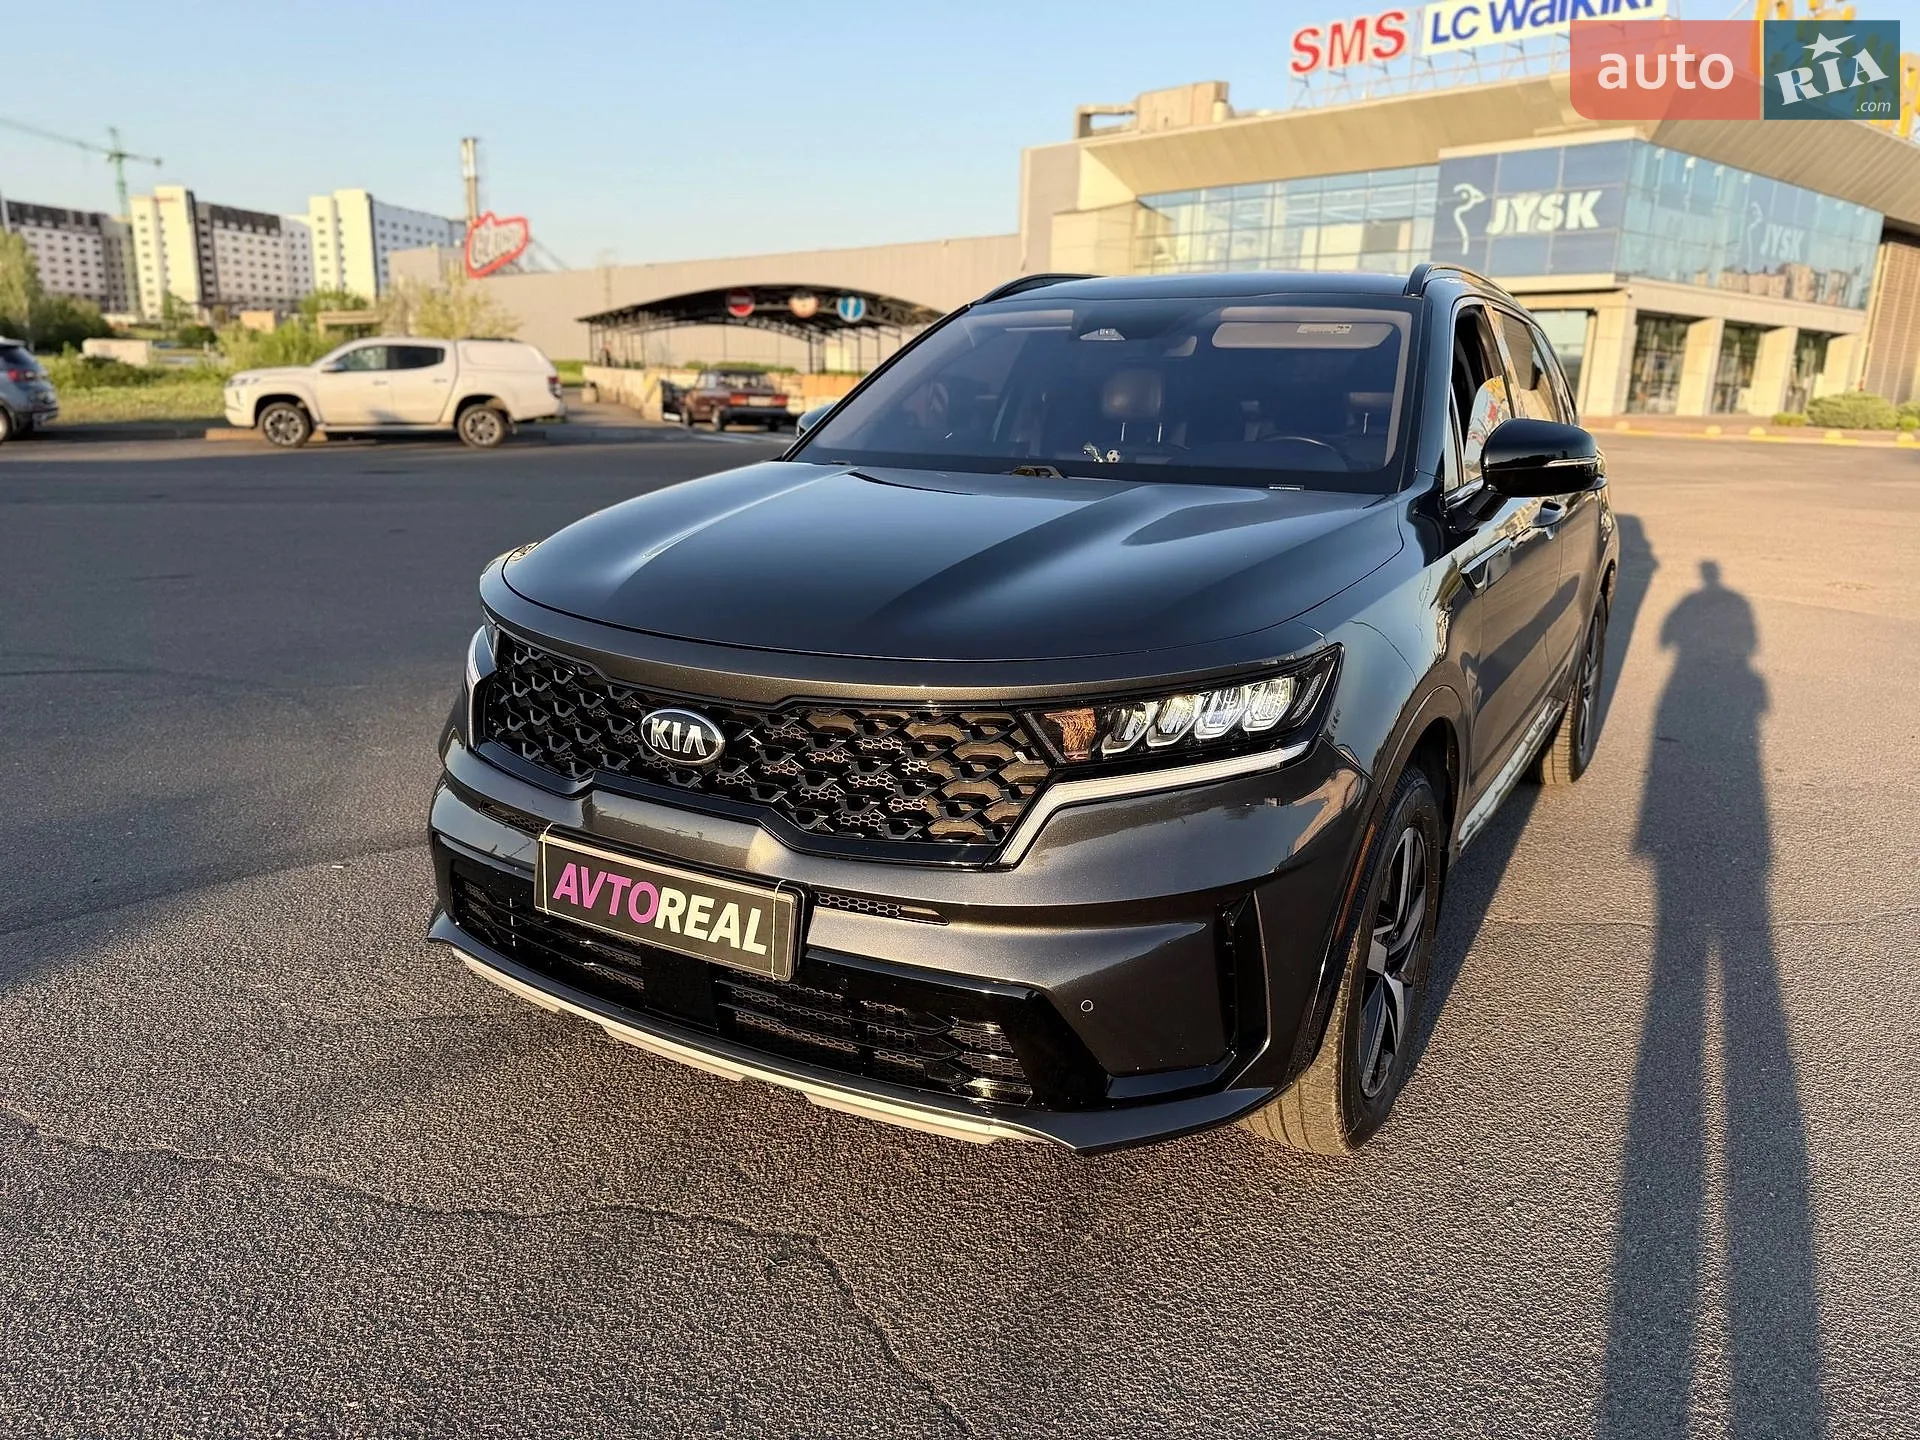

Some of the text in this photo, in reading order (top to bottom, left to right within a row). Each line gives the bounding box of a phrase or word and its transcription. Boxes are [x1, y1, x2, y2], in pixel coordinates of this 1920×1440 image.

[1291, 11, 1407, 73] SMS
[1431, 0, 1654, 44] LC Waik
[1486, 190, 1603, 235] JYSK
[1760, 222, 1806, 261] JYSK
[651, 717, 707, 756] KIA
[552, 862, 768, 956] AVTOREAL
